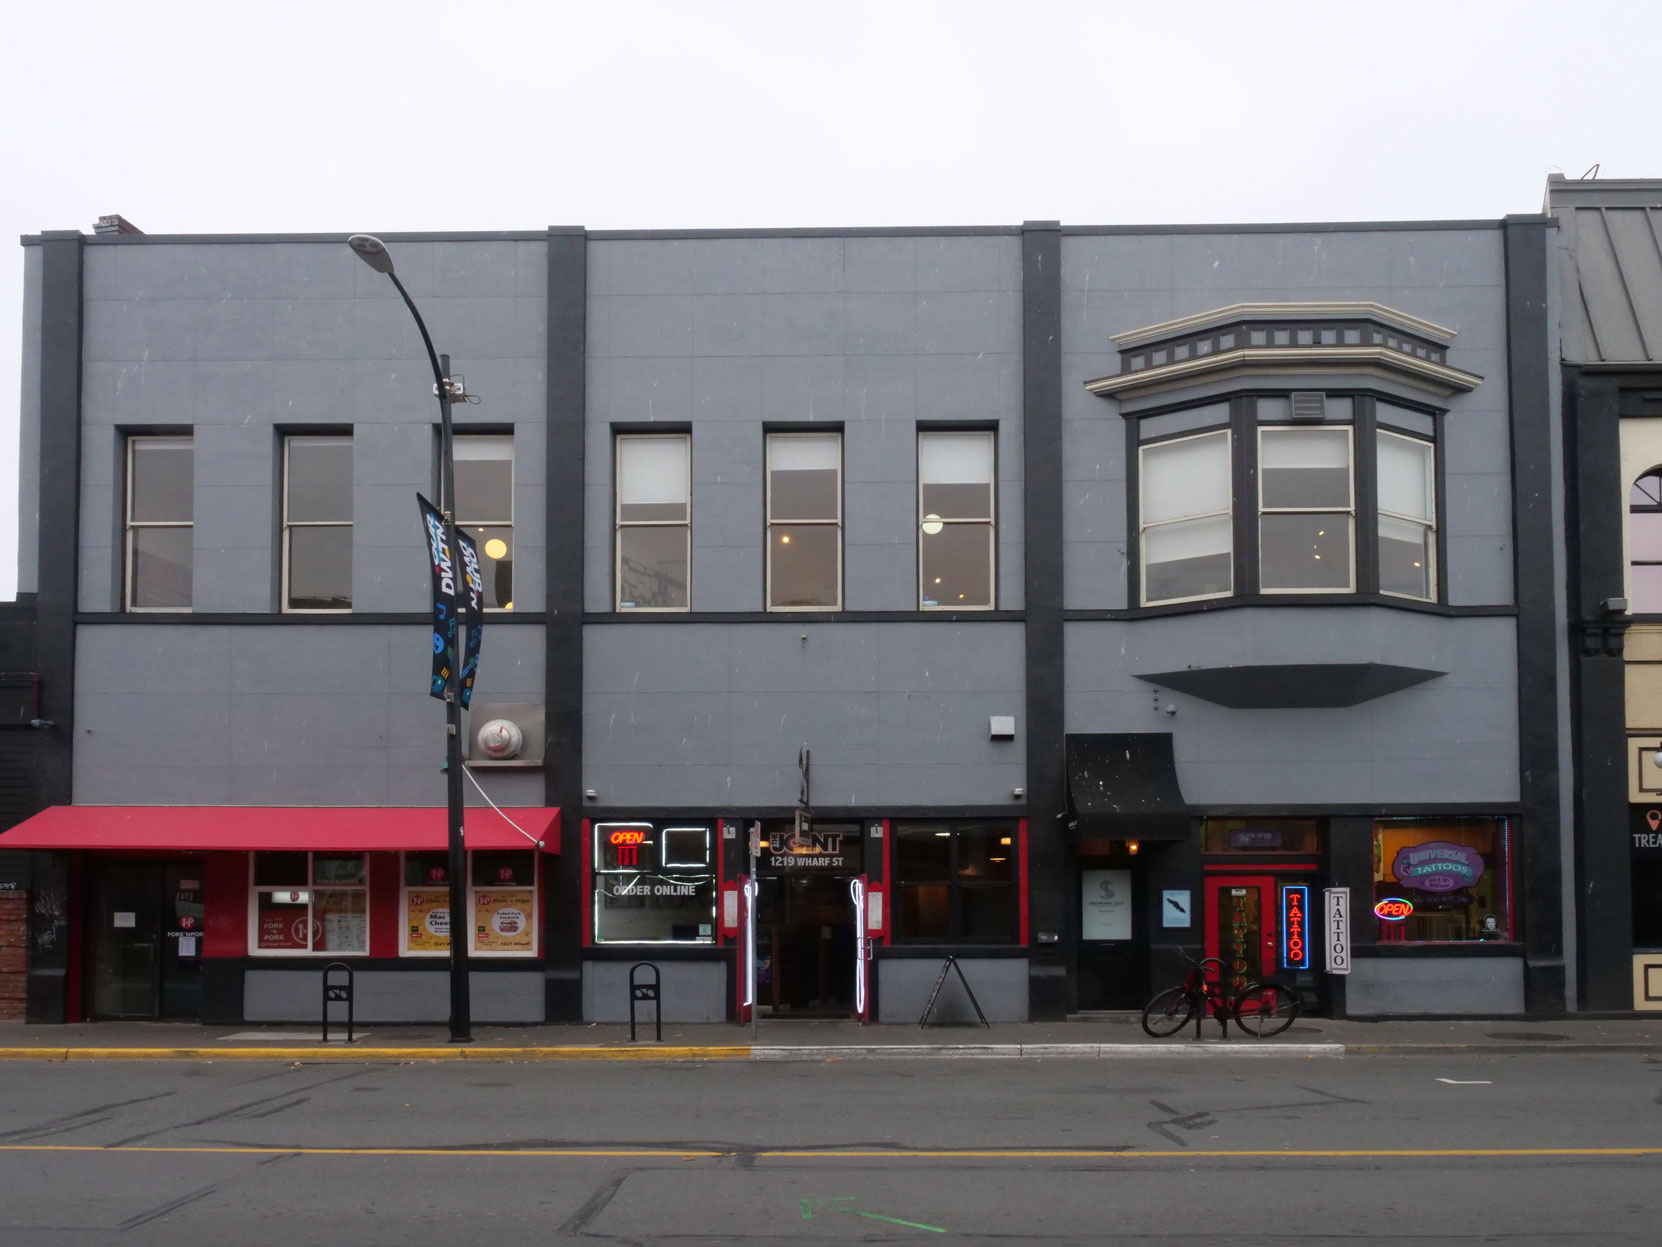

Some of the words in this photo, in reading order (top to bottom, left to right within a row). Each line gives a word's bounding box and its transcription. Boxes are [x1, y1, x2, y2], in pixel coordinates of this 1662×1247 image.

[610, 831, 645, 845] OPEN
[770, 856, 795, 867] 1219
[796, 857, 830, 867] WHARF
[831, 857, 845, 867] ST
[1409, 848, 1468, 865] UNIVERSAL
[1417, 862, 1468, 874] TATTOOS
[613, 885, 651, 896] ORDER
[654, 885, 696, 896] ONLINE
[1376, 903, 1410, 916] OPEN
[1288, 894, 1303, 961] TATTOO
[1332, 896, 1345, 966] TATTOO
[1231, 897, 1248, 991] TATTOO
